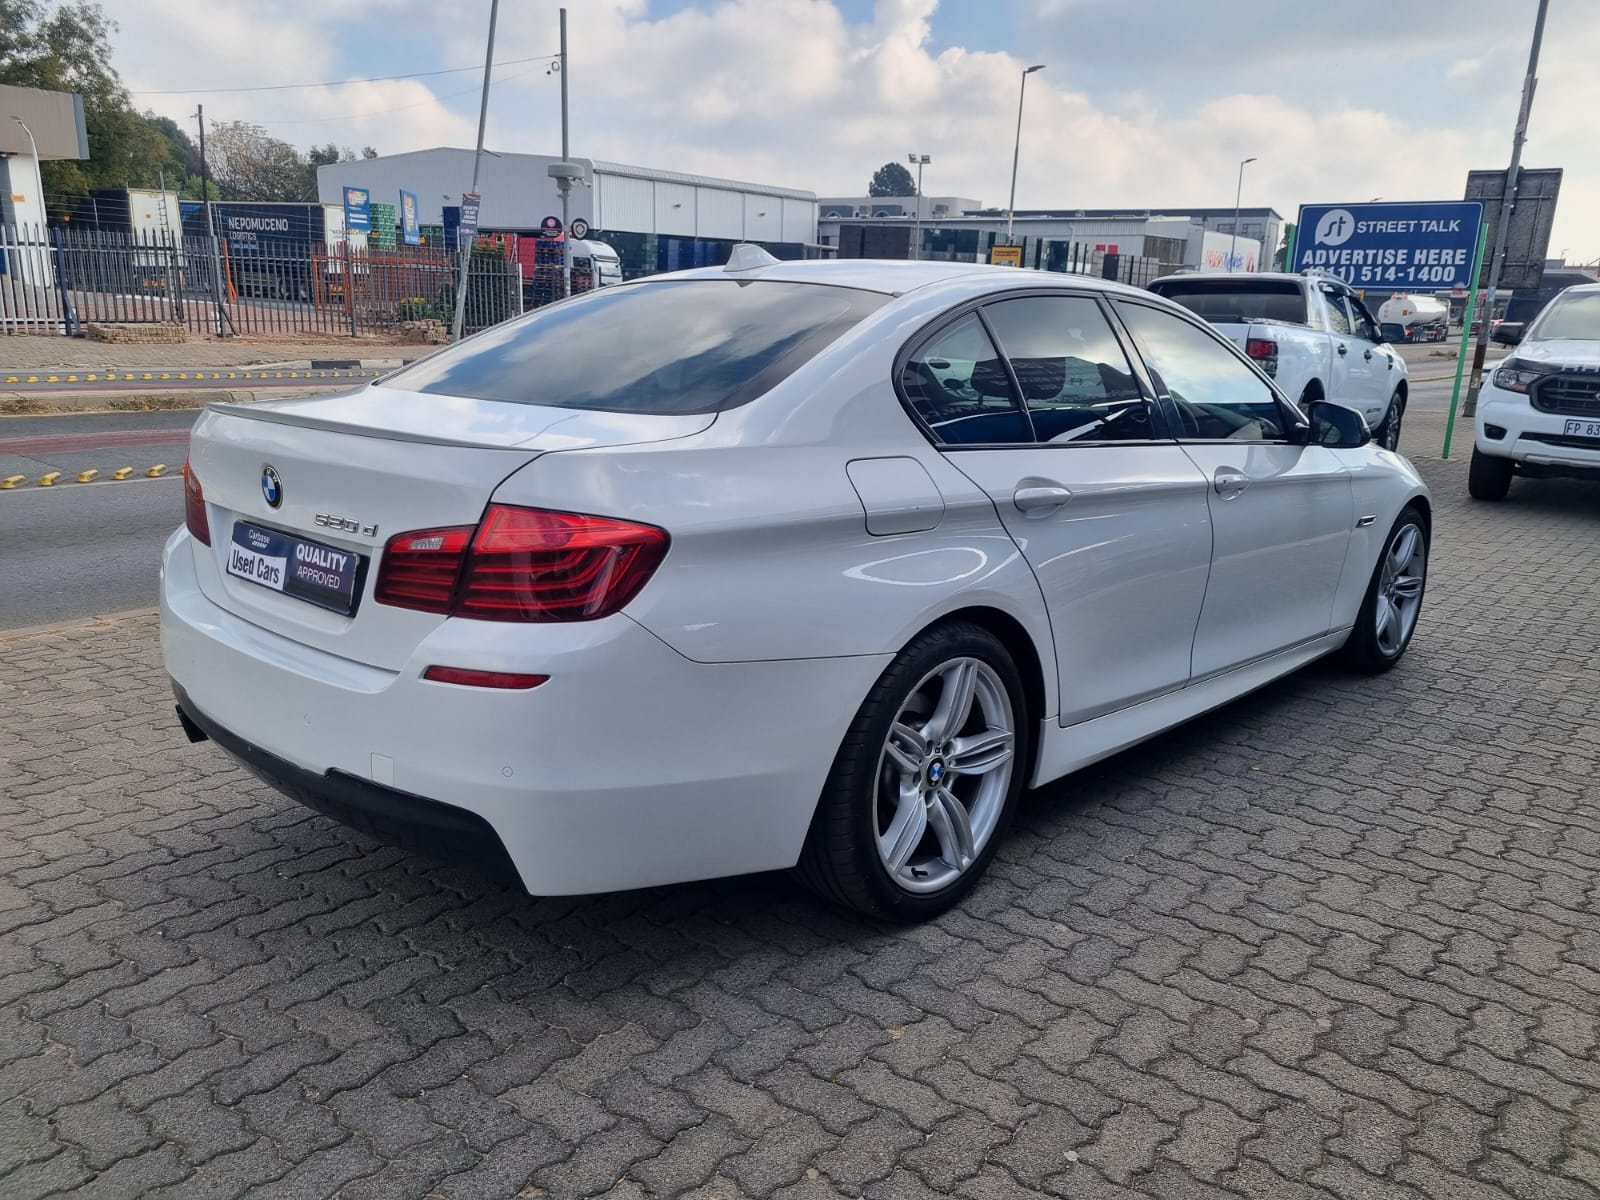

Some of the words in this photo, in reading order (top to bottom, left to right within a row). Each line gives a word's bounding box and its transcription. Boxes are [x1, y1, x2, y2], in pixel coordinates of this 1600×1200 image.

[228, 216, 289, 232] NEPOMUCENO
[1357, 221, 1419, 233] STREET
[1421, 220, 1461, 232] TALK
[229, 231, 257, 241] LOGISTICS
[1301, 249, 1407, 265] ADVERTISE
[1413, 248, 1467, 265] HERE
[1360, 266, 1456, 282] 514-1400
[1566, 422, 1580, 433] FP
[315, 512, 358, 533] 520
[296, 543, 348, 572] QUALITY
[232, 549, 256, 576] Used
[256, 557, 280, 585] Cars
[296, 565, 340, 589] APPROVED
